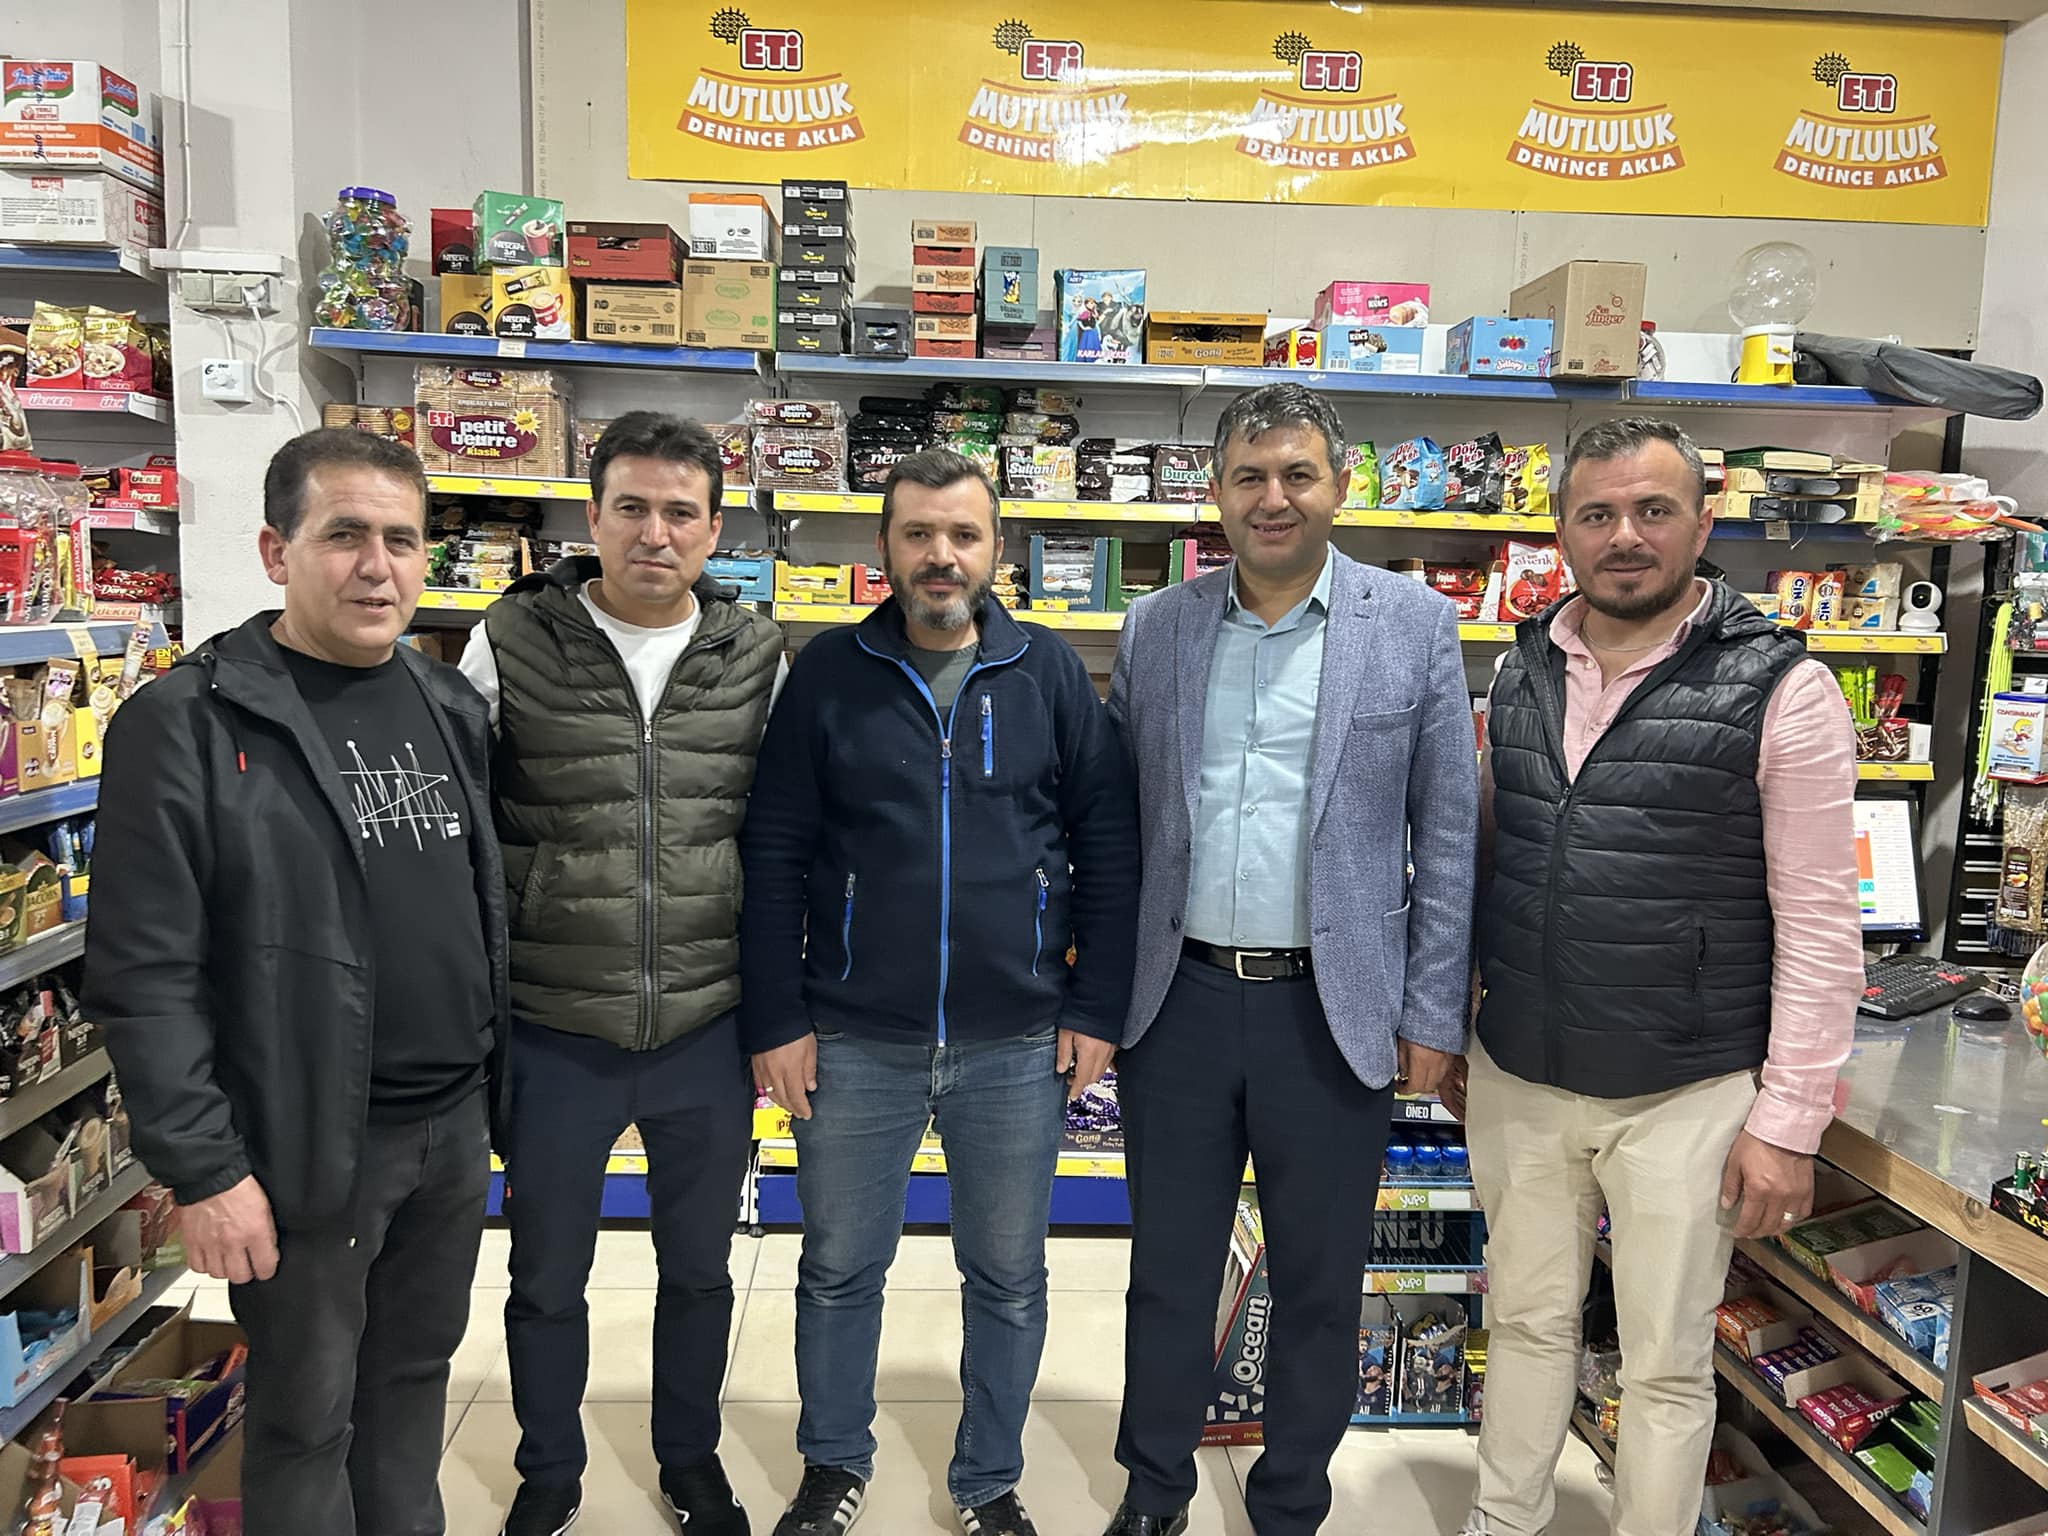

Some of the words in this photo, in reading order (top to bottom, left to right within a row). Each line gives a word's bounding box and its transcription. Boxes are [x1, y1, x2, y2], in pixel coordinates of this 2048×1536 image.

[687, 76, 854, 123] MUTLULUK
[1250, 97, 1407, 144] MUTLULUK
[1518, 107, 1677, 153] MUTLULUK
[798, 125, 856, 147] AKLA
[1785, 117, 1938, 162] MUTLULUK
[1351, 144, 1407, 166] AKLA
[1620, 153, 1676, 176] AKLA
[1885, 163, 1939, 185] AKLA
[1585, 309, 1625, 327] finger
[28, 393, 72, 407] ÜLKER
[780, 410, 812, 419] beurre
[460, 421, 507, 434] petit
[451, 431, 517, 448] beurre
[778, 456, 820, 467] beurre
[784, 449, 814, 459] petit
[1232, 1294, 1272, 1385] Ocean
